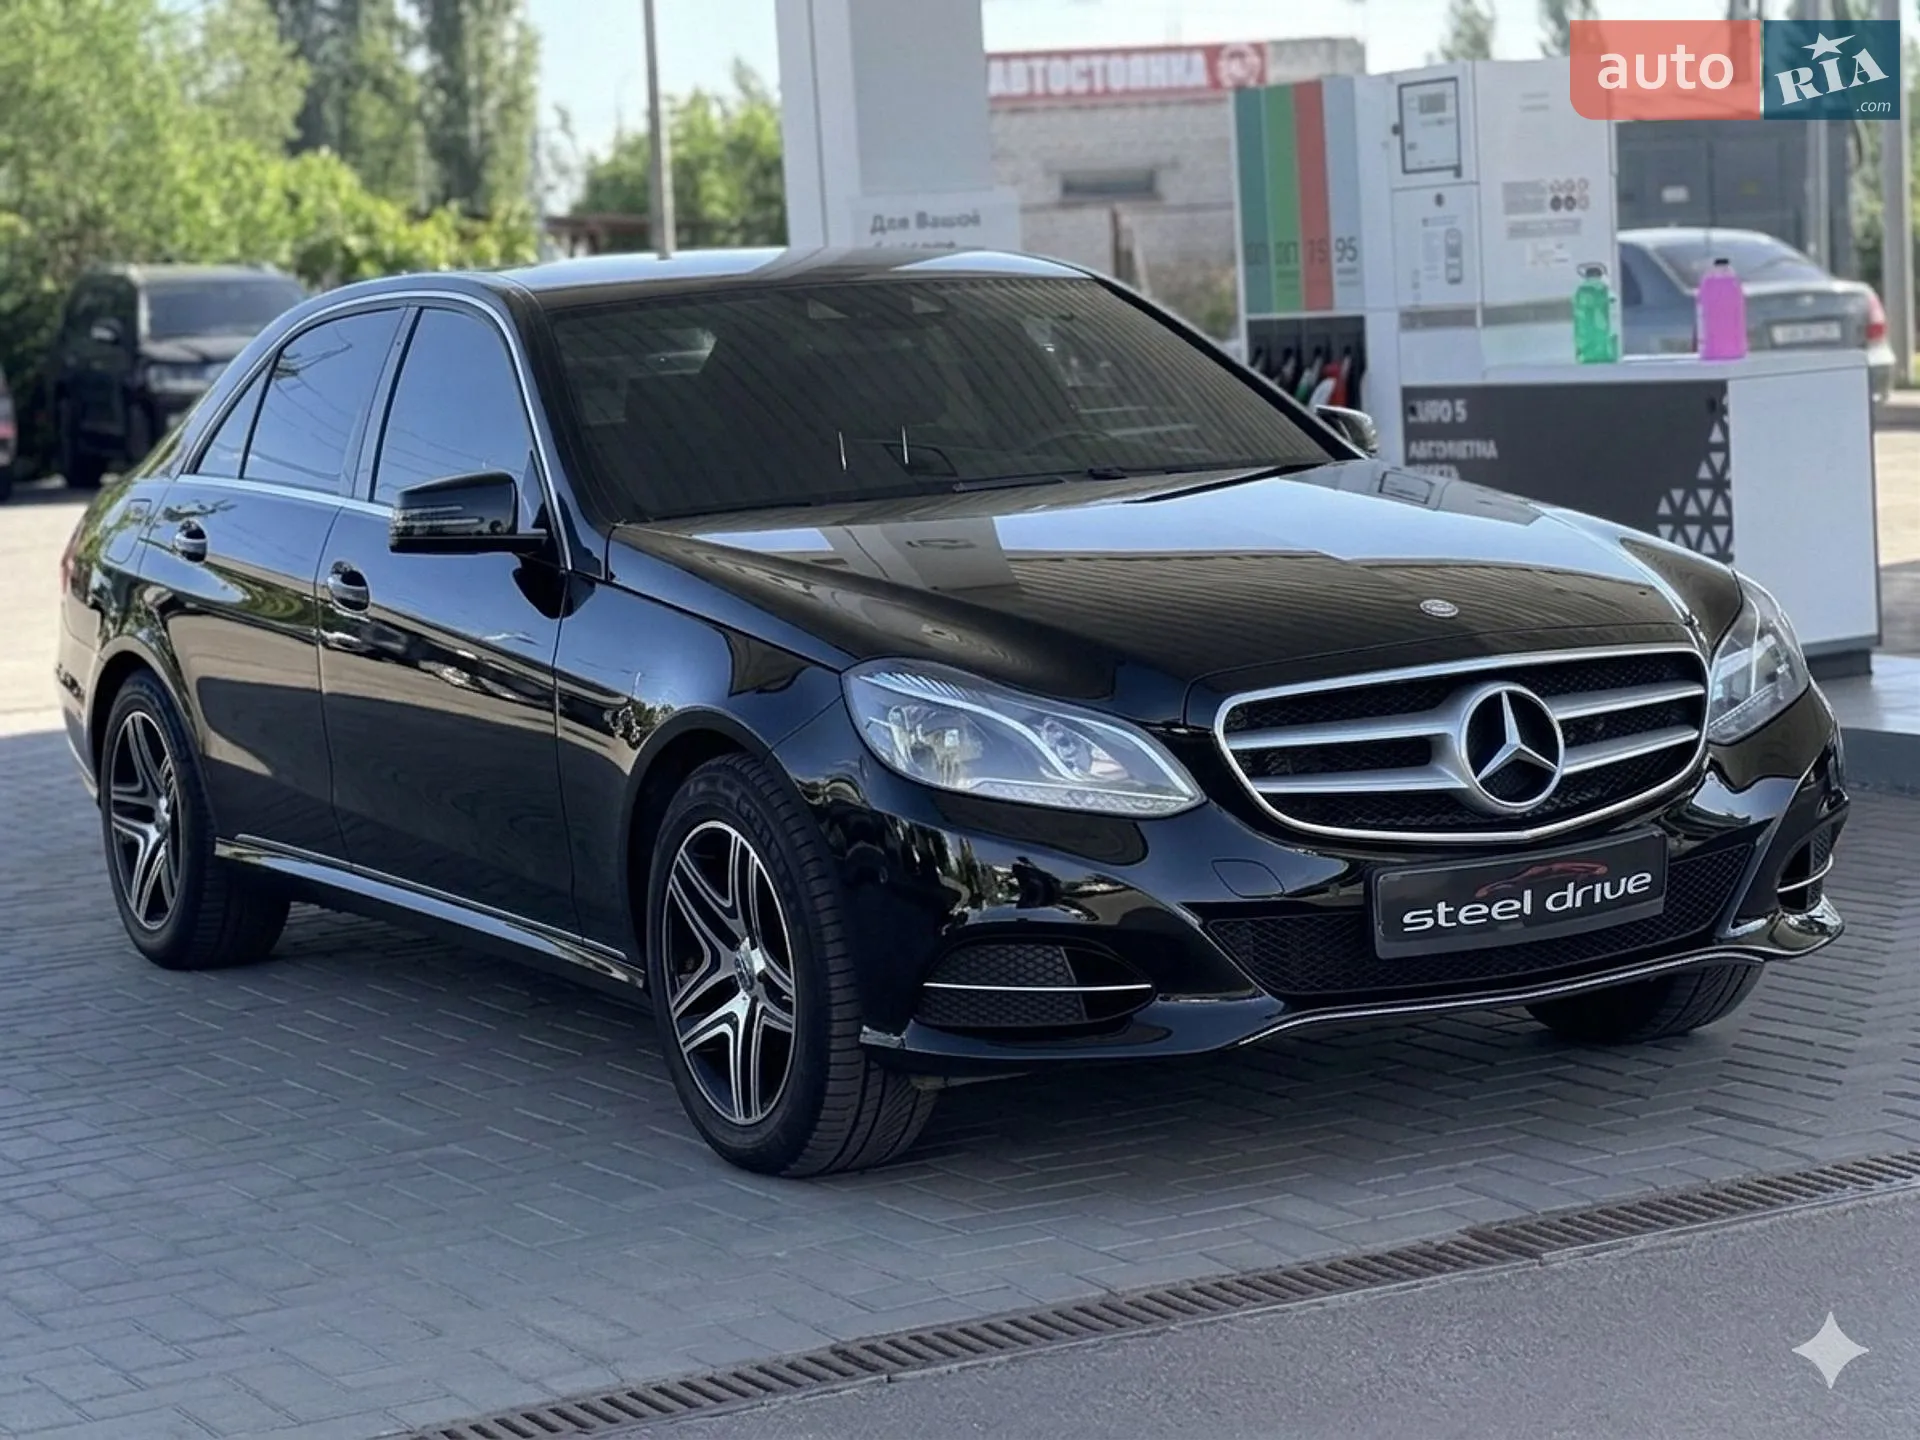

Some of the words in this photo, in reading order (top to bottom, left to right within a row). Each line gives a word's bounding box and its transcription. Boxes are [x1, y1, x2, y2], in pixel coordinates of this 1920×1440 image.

[1335, 236, 1358, 263] 95
[1454, 398, 1468, 423] 5
[1402, 888, 1532, 932] steel
[1545, 871, 1652, 914] drive
